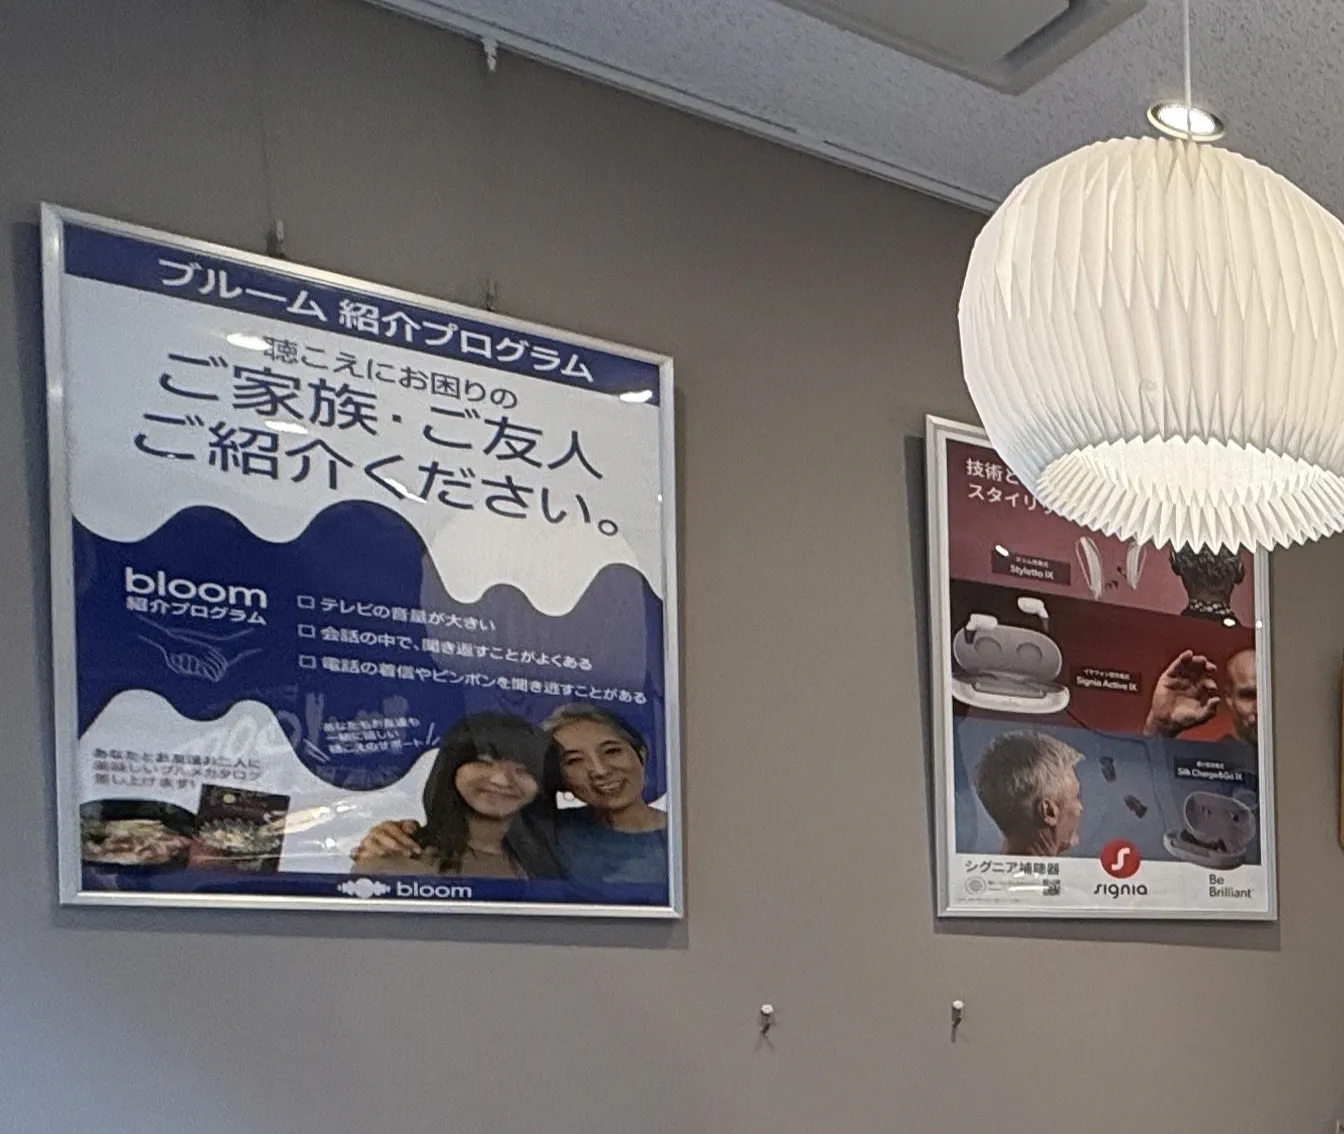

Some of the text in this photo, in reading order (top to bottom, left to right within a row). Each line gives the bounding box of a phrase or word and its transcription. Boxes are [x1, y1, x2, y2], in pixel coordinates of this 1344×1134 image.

[158, 258, 595, 383] ブルーム 紹介プログラム
[263, 335, 518, 410] 聴こえにお困りの
[158, 353, 604, 480] ご家族・ご友人
[134, 412, 620, 538] ご紹介ください。
[124, 566, 268, 608] bloom
[125, 596, 267, 625] 紹介プログラム
[320, 598, 496, 632] テレビの音量が大きい
[964, 860, 1060, 876] シグニア補聴器
[1209, 874, 1225, 886] Be
[396, 880, 472, 899] bloom
[1093, 883, 1149, 899] signia
[1209, 886, 1252, 898] Brilliant
